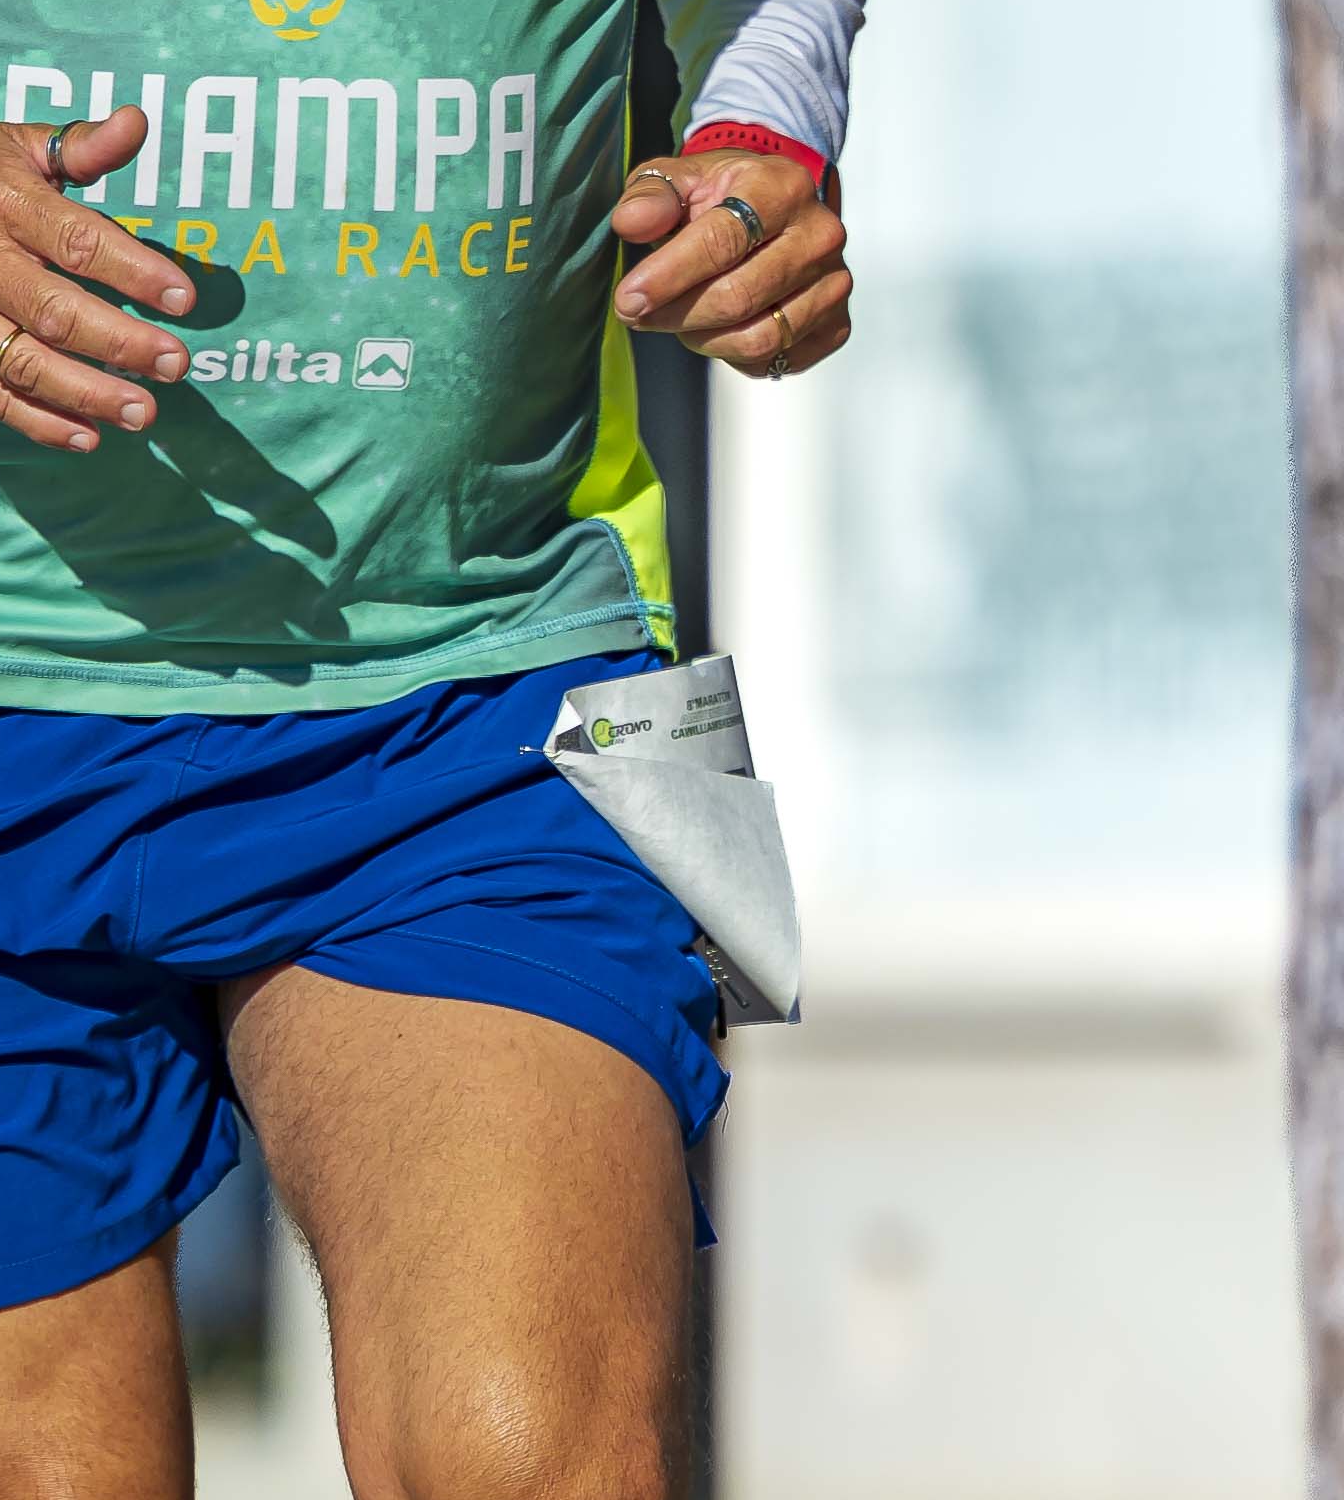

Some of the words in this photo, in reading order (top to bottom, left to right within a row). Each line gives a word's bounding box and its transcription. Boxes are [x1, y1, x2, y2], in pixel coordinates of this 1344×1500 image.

[113, 215, 287, 276] TRA
[336, 216, 533, 278] RACE
[104, 339, 342, 384] silta
